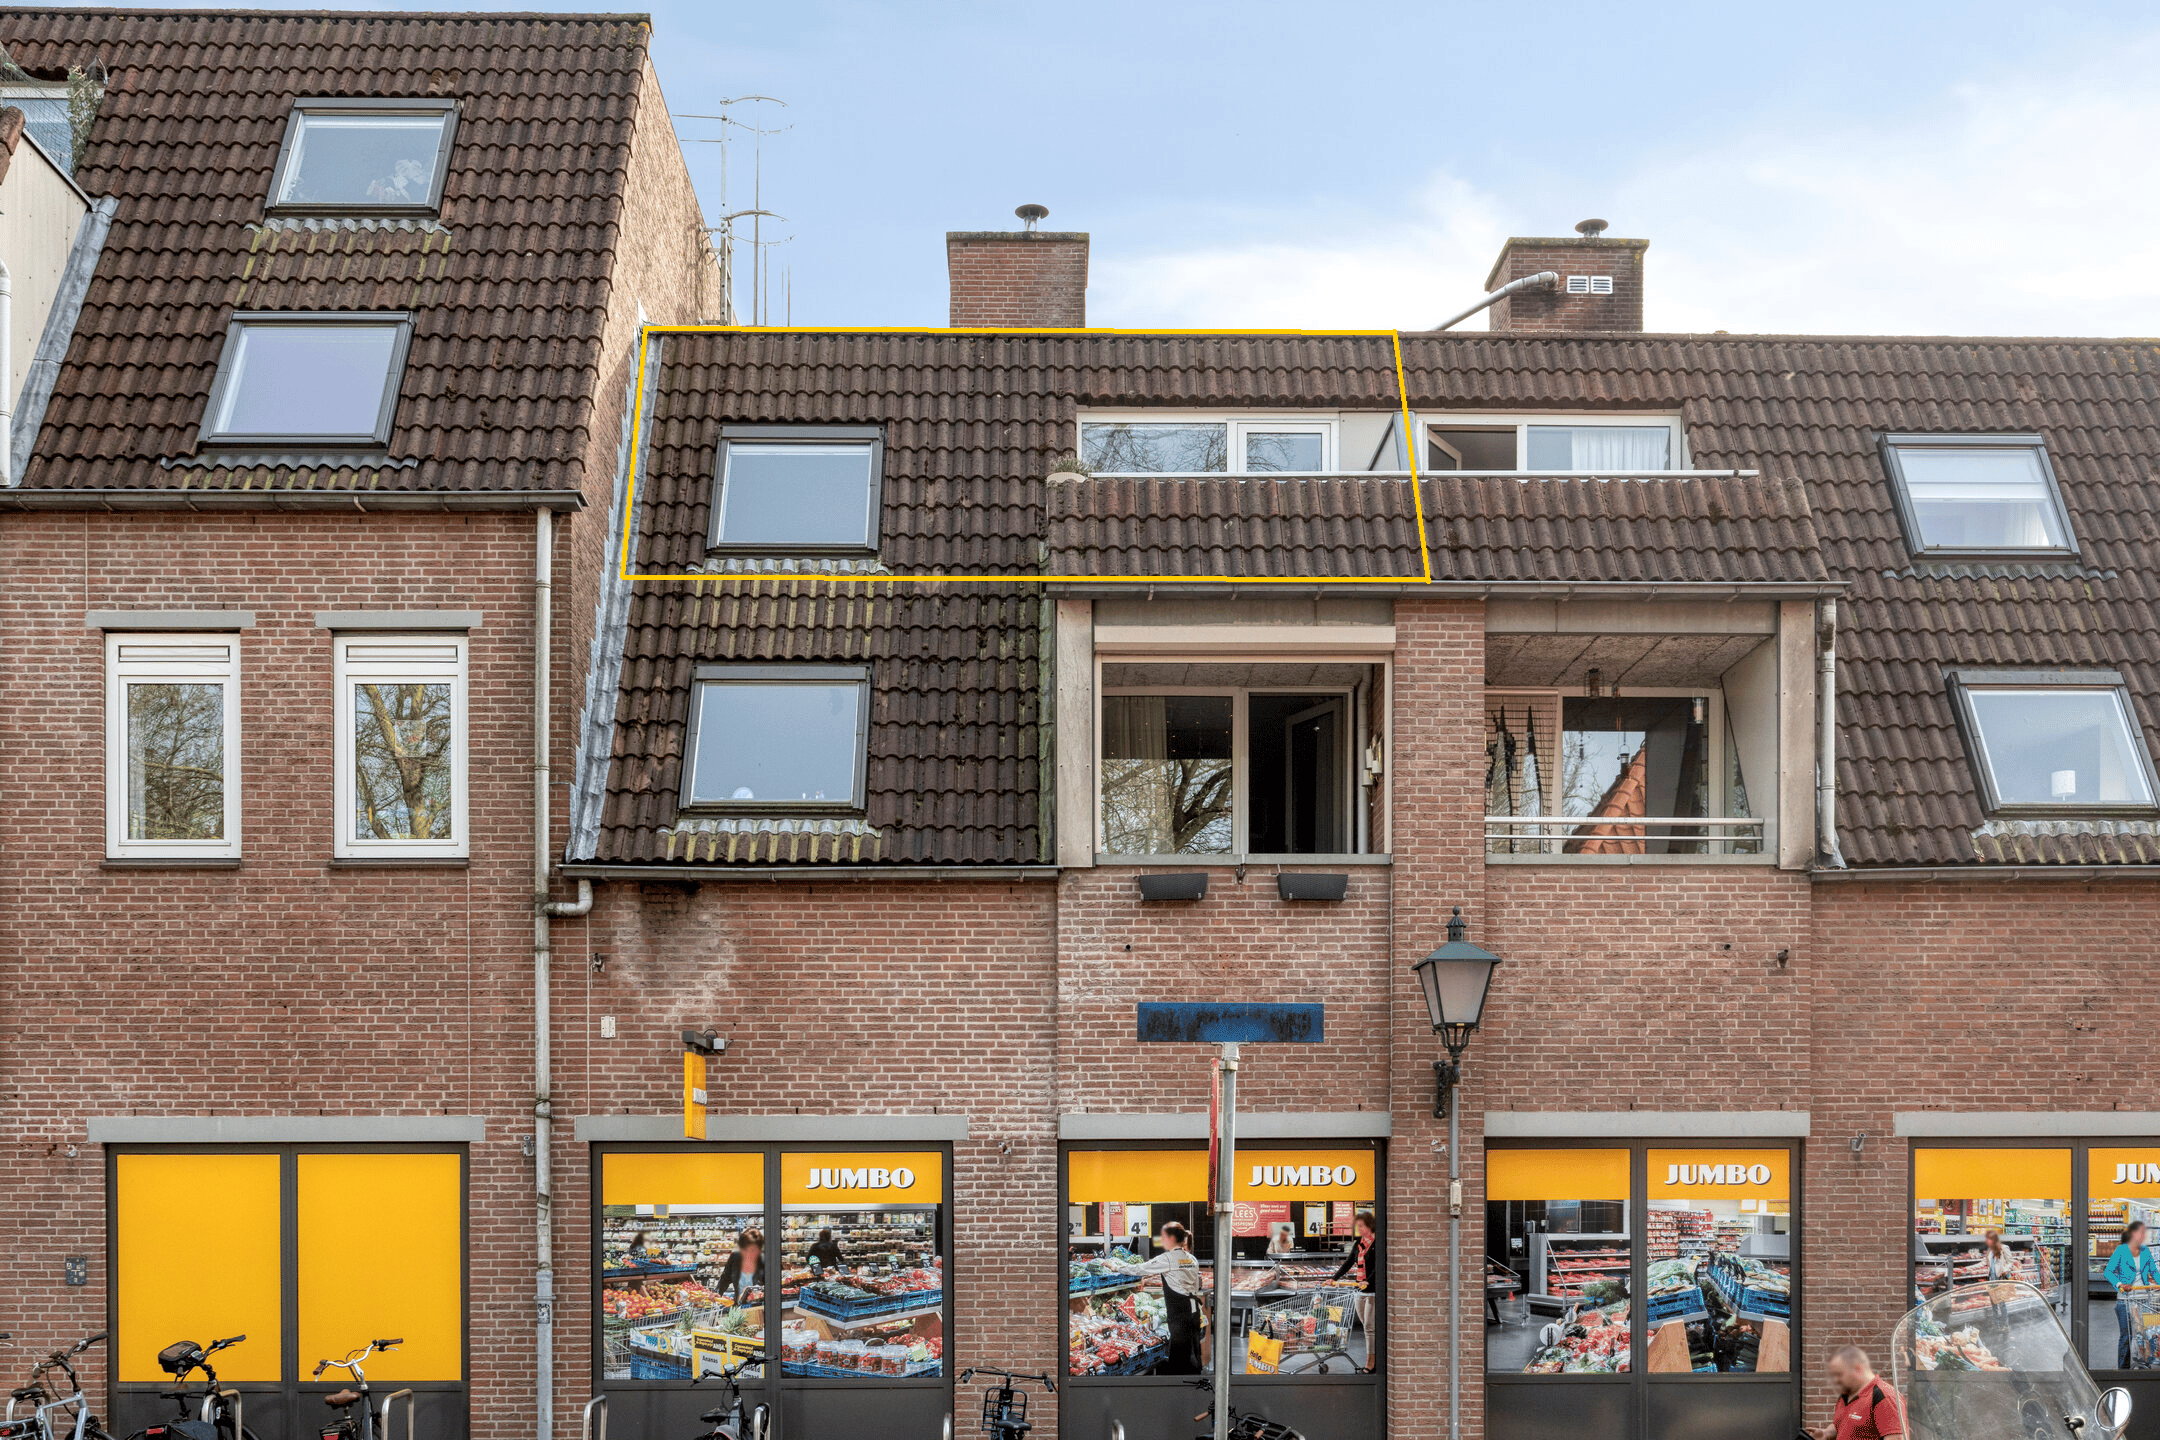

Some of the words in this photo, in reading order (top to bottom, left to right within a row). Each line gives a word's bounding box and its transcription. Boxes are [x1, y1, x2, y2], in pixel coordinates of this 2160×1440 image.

[805, 1167, 916, 1190] JUMBO
[1247, 1164, 1357, 1187] JUMBO
[1663, 1163, 1772, 1186] JUMBO
